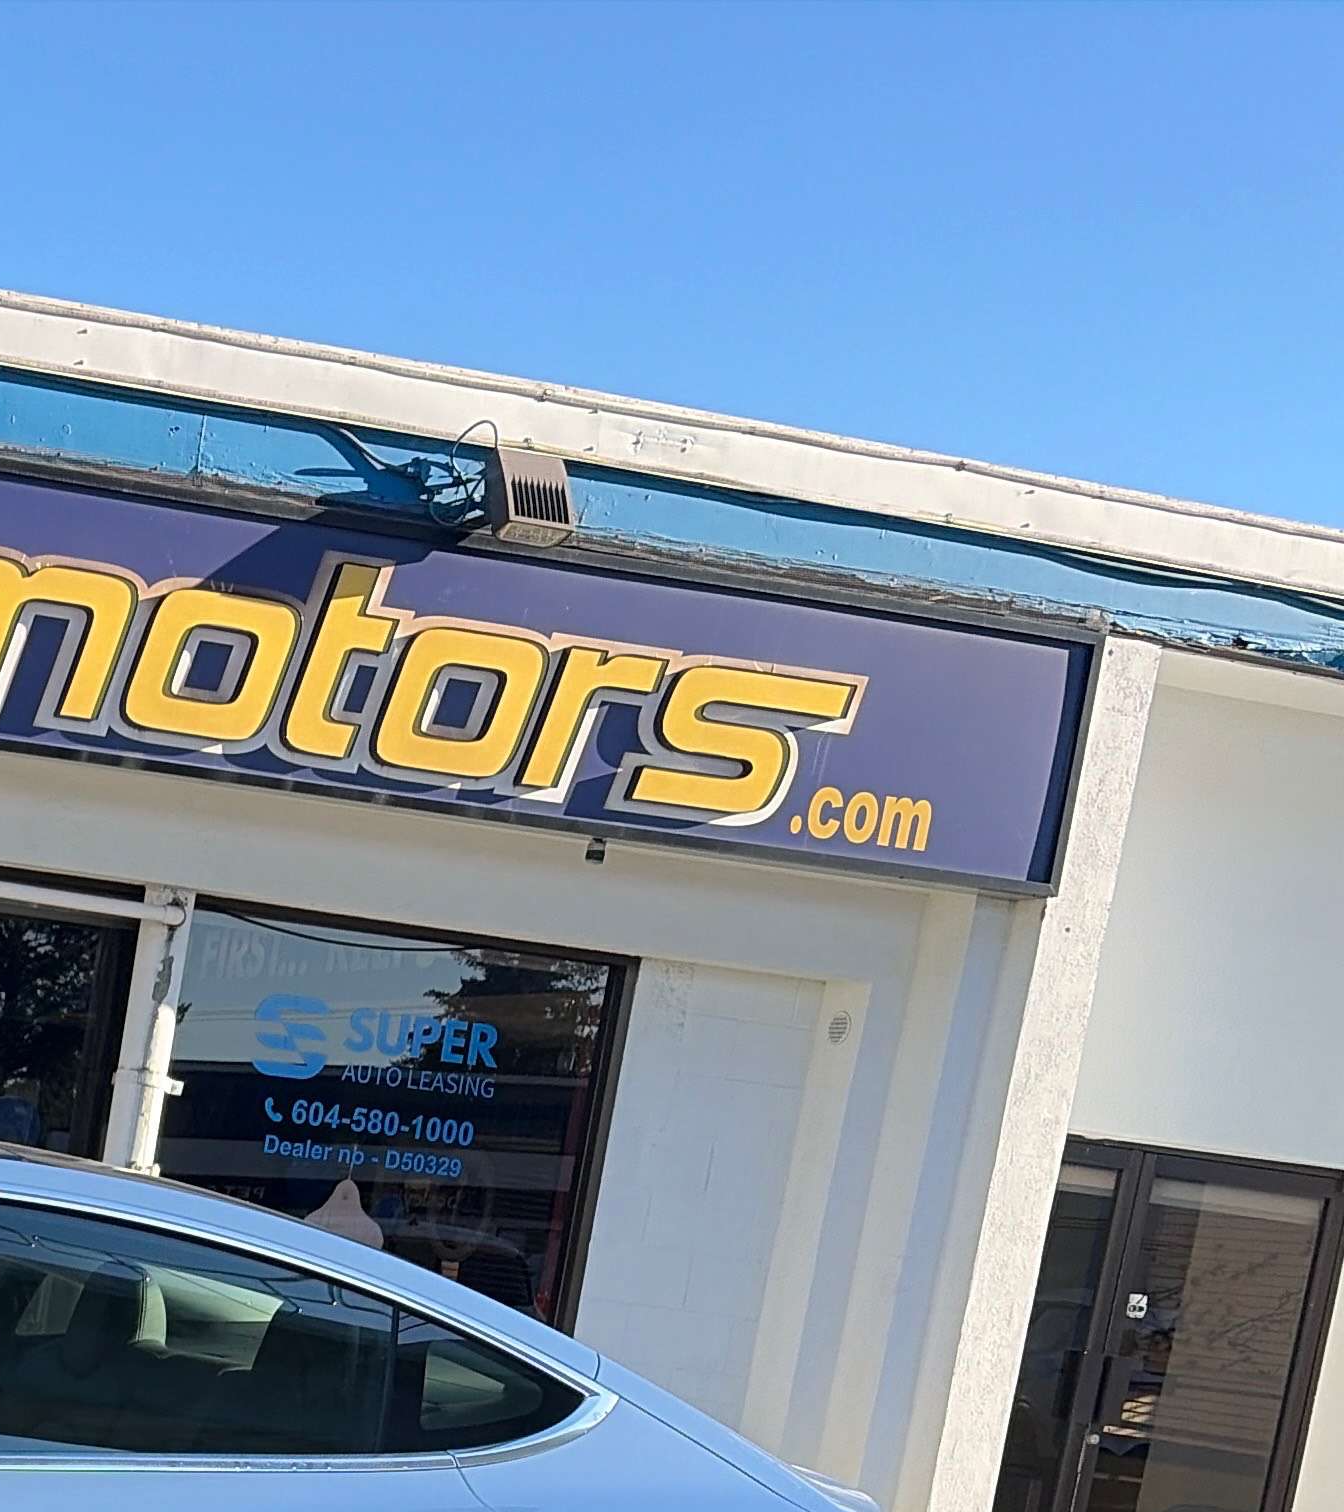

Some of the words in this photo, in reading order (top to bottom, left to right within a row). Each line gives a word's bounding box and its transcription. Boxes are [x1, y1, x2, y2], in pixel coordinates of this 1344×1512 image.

[790, 786, 932, 852] .com
[343, 1007, 499, 1069] SUPER
[341, 1064, 402, 1088] AUTO
[407, 1070, 495, 1099] LEASING
[291, 1100, 474, 1146] 604-580-1000
[263, 1134, 333, 1161] Dealer
[384, 1149, 462, 1178] D50329
